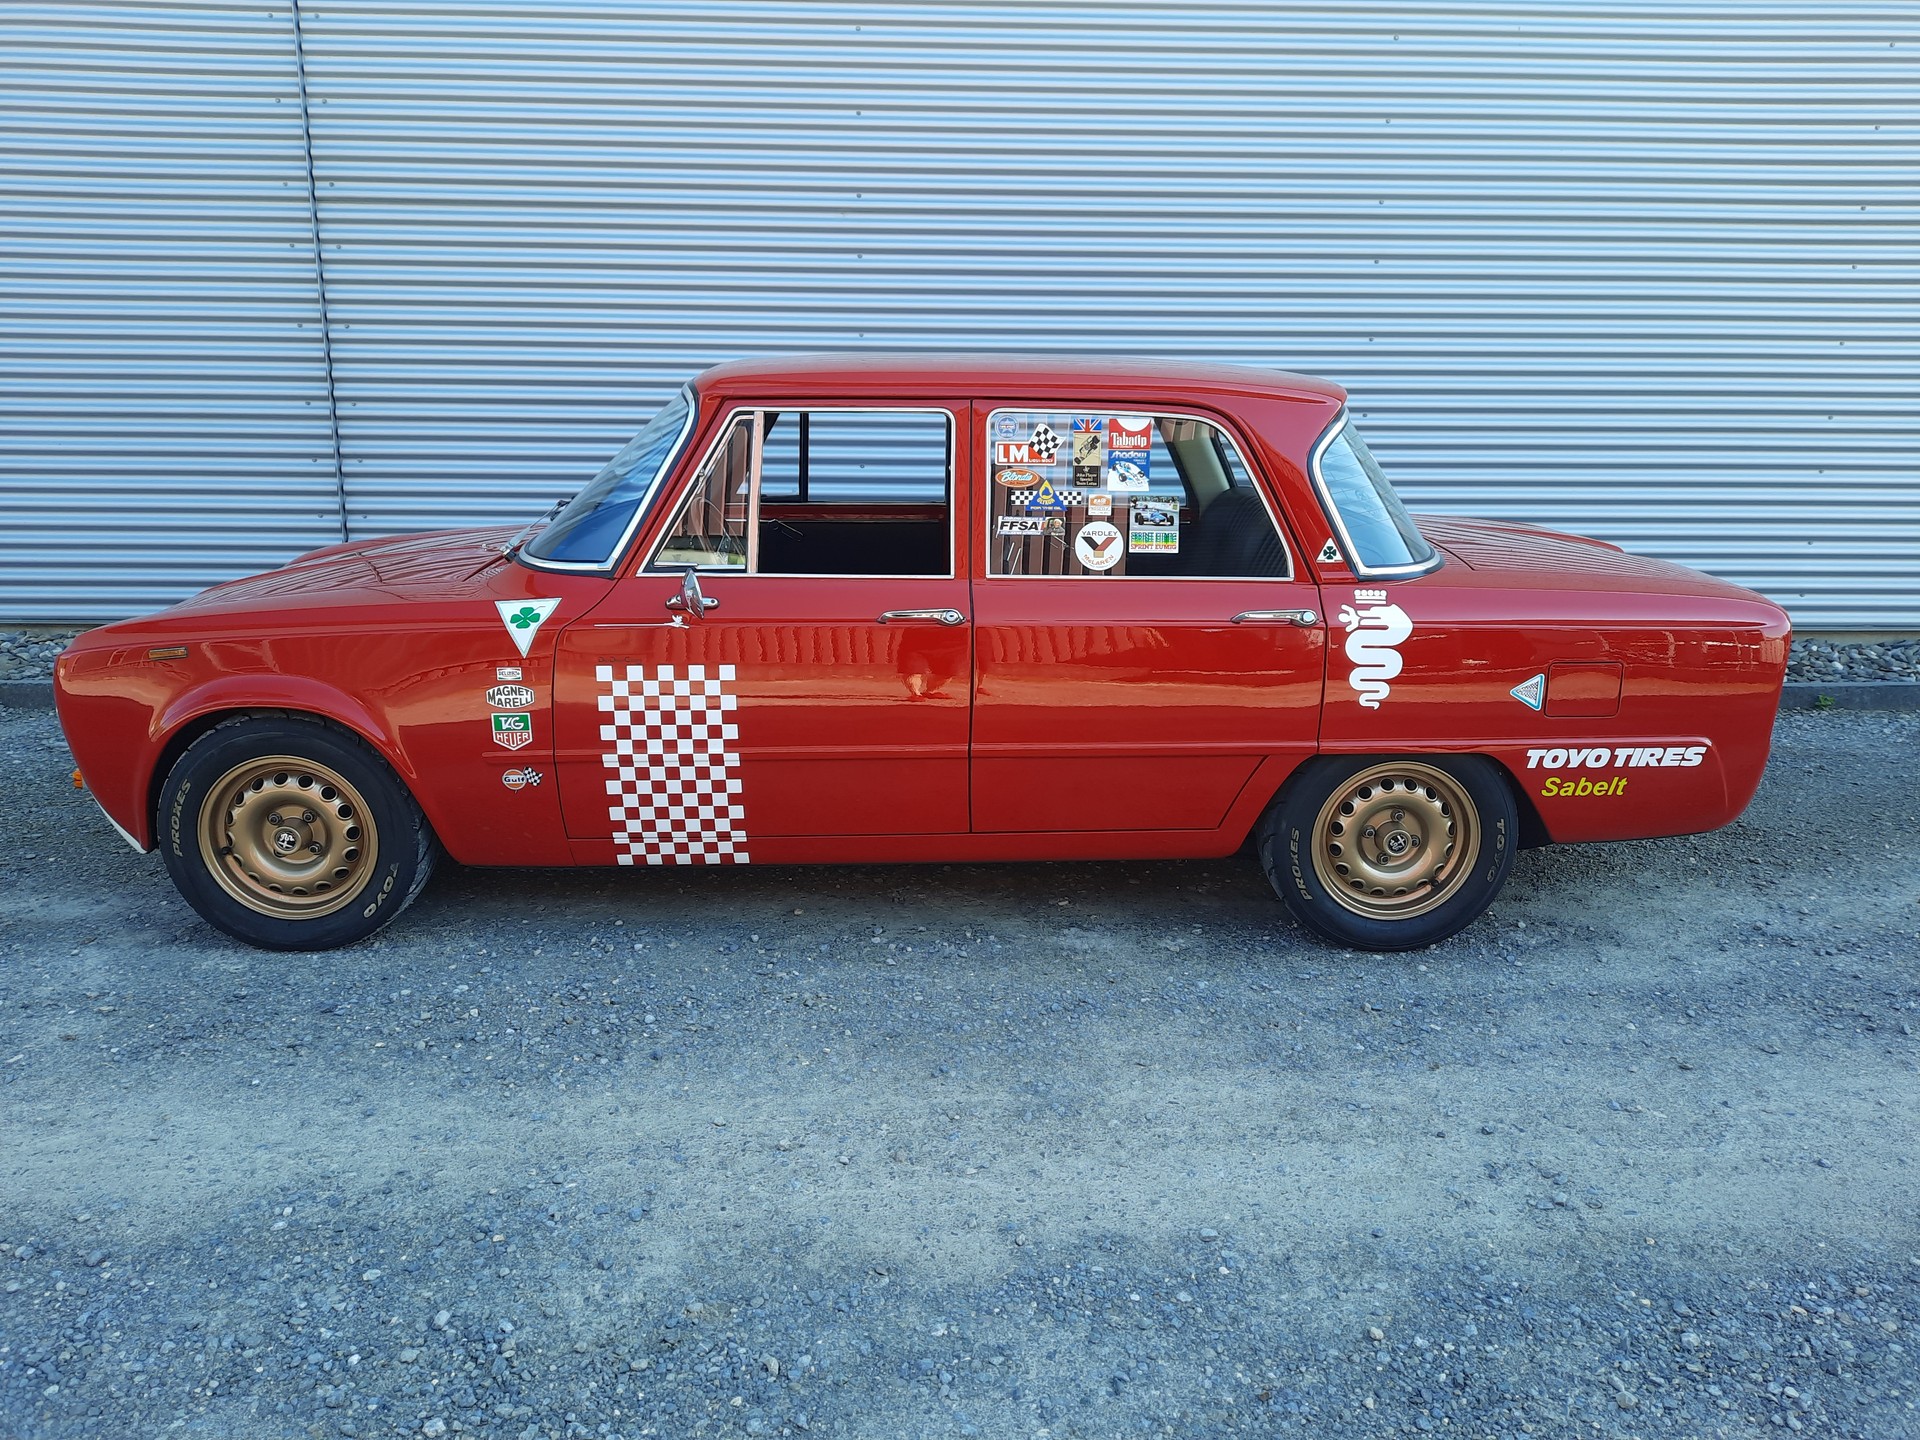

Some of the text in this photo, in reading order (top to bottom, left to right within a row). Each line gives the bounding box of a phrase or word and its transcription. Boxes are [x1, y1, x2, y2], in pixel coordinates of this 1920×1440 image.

[1110, 432, 1147, 448] Tabatip
[998, 445, 1029, 463] LM
[1110, 450, 1147, 459] shadow
[1000, 521, 1039, 531] FFSA
[487, 685, 533, 704] MAGNETI
[499, 716, 525, 730] TAG
[496, 732, 529, 747] HEUER
[1526, 746, 1707, 769] TOYO TIRES
[1541, 776, 1628, 797] Sabelt
[171, 778, 191, 857] PROXES
[1487, 818, 1505, 882] TOYO
[1290, 827, 1313, 900] PROXES
[363, 862, 399, 918] TOYO
